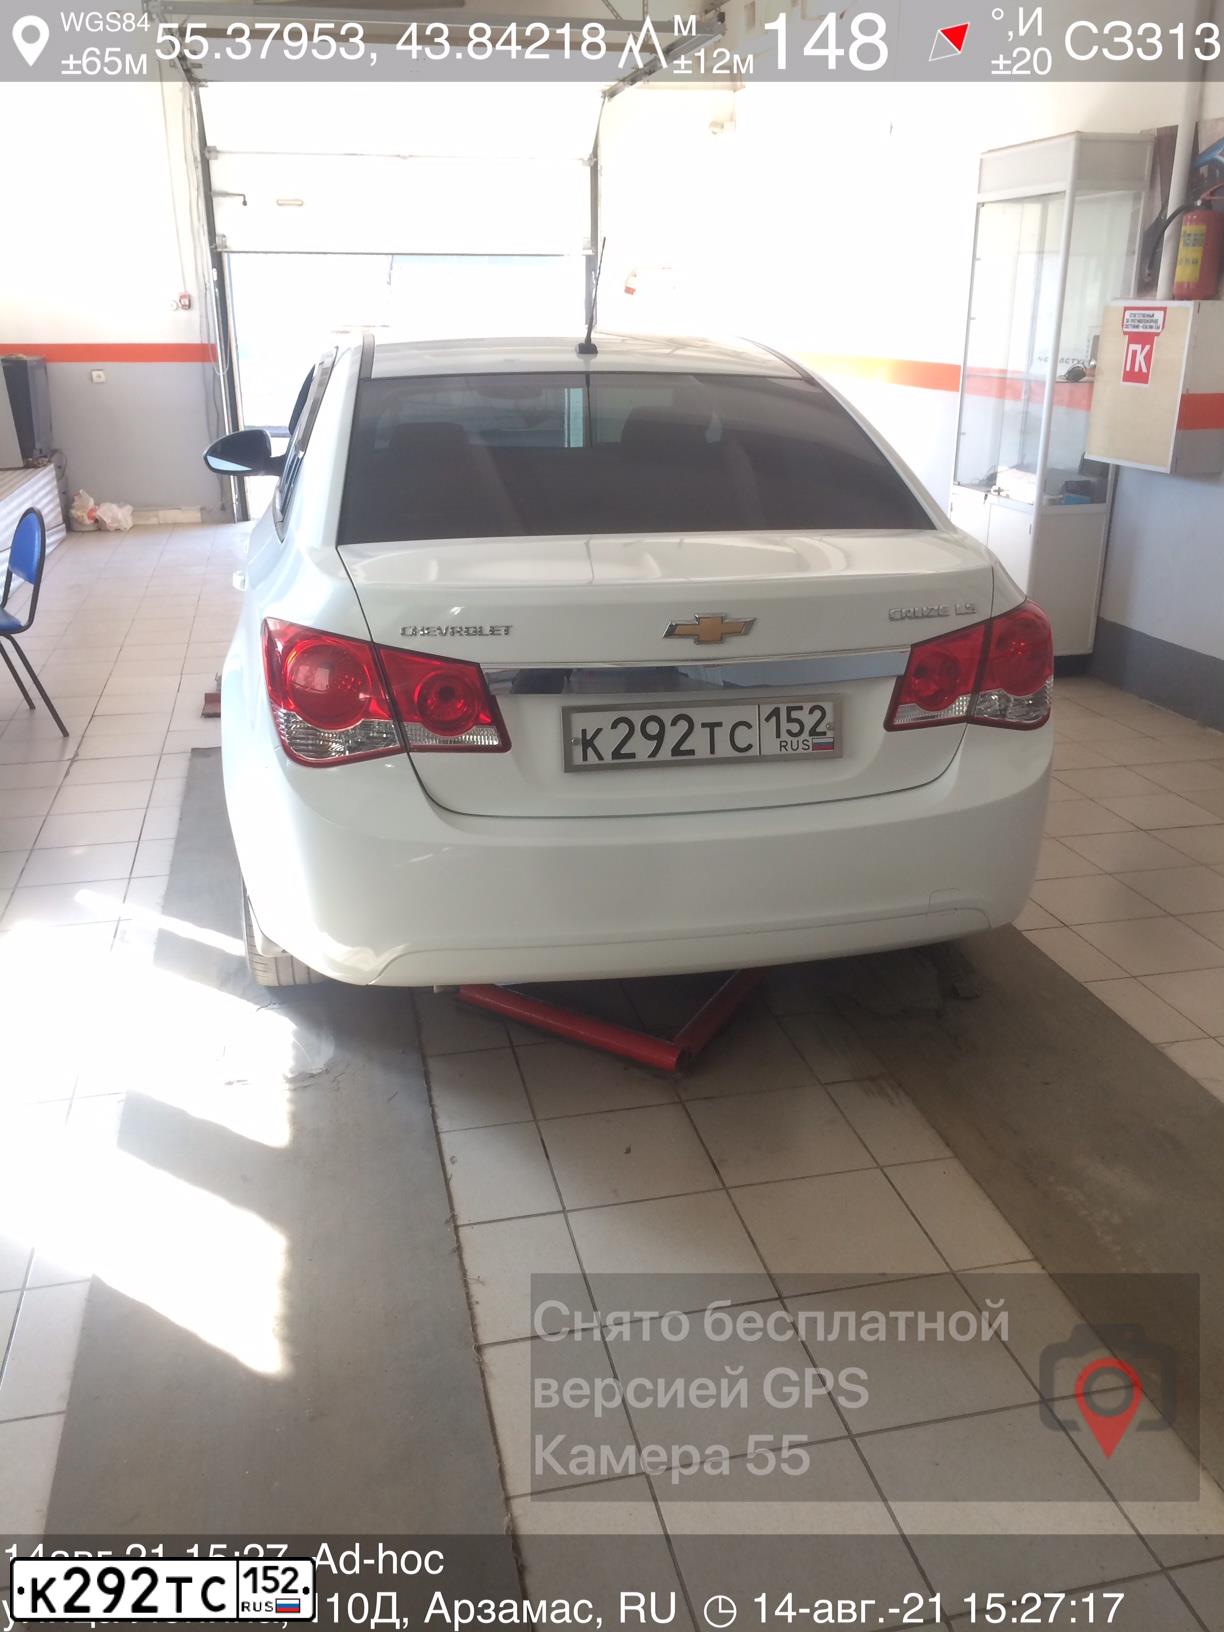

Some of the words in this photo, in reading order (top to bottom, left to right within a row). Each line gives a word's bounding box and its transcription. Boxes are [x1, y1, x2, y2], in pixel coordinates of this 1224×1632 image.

[1125, 343, 1151, 373] ПК
[400, 624, 513, 637] CHEVROLET
[764, 704, 827, 739] 152
[779, 739, 811, 752] RUS
